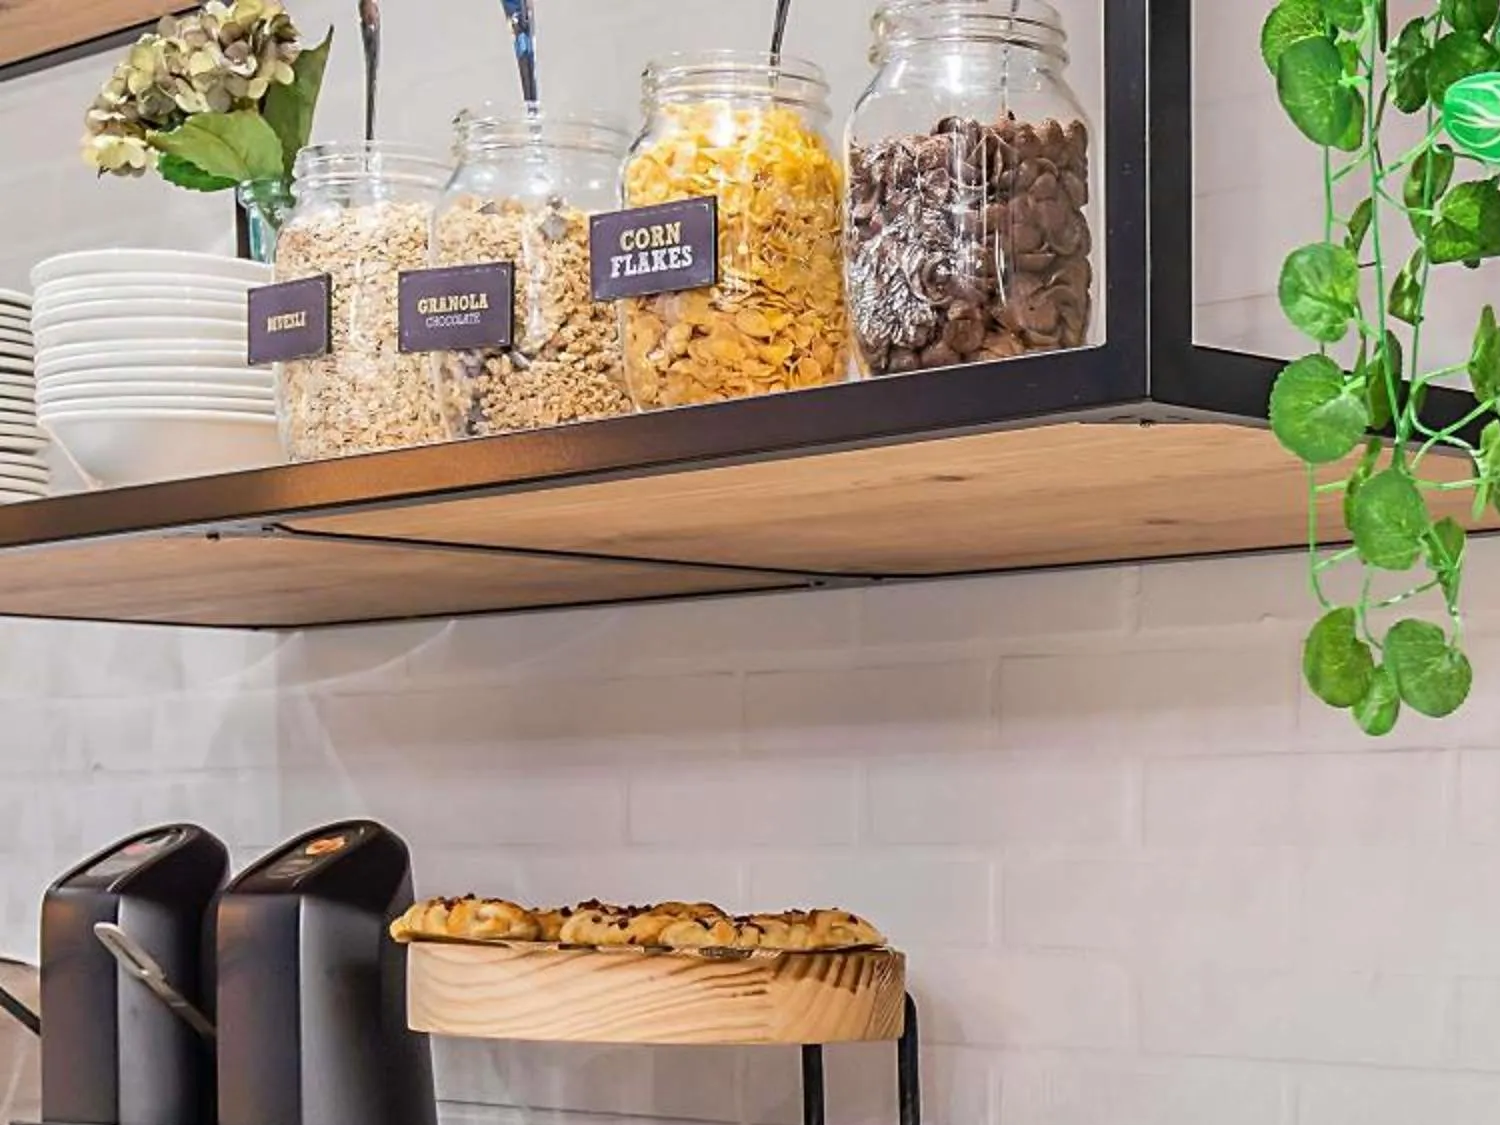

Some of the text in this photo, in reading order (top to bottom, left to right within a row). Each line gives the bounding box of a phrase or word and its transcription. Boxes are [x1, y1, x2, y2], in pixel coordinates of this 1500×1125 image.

[620, 221, 681, 252] CORN
[610, 245, 693, 278] FLAKES
[417, 293, 488, 315] GRANOLA
